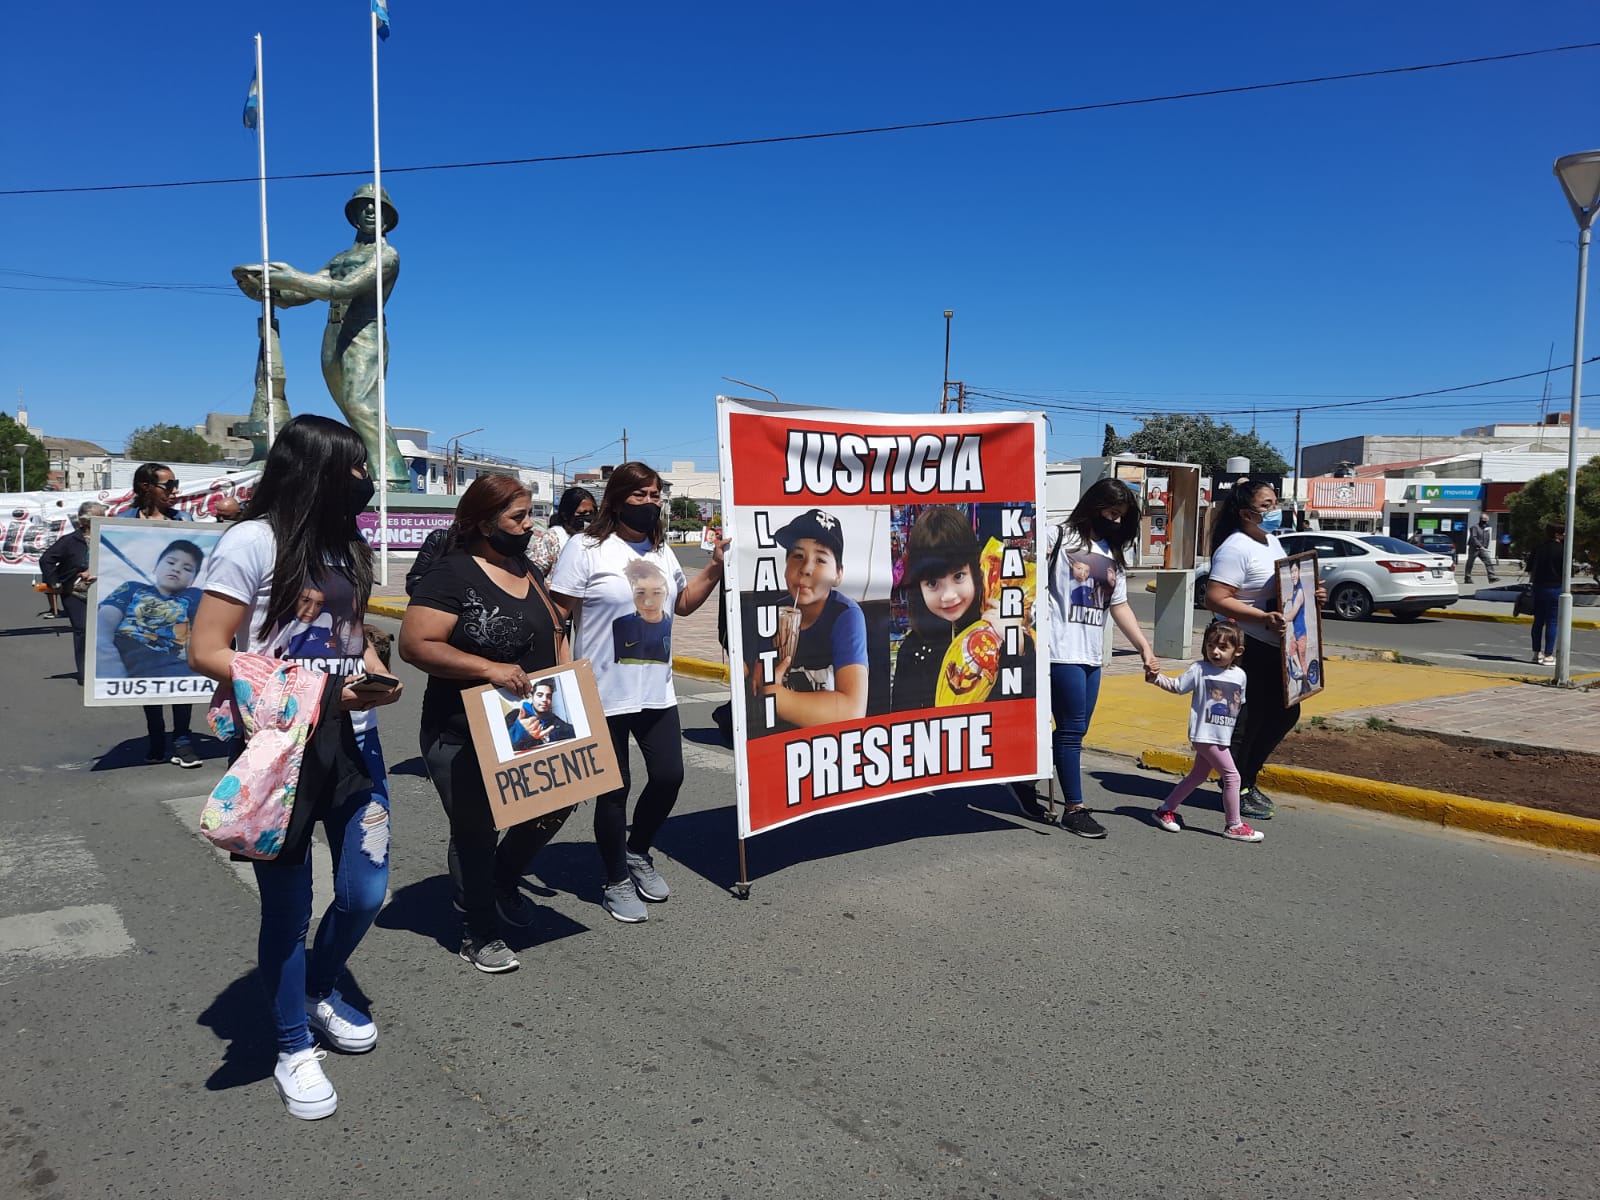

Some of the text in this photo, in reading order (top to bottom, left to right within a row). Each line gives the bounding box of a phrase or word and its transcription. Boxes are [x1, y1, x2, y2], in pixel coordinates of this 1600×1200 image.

[783, 430, 984, 494] JUSTICIA
[1443, 488, 1474, 496] movistar
[401, 518, 413, 526] DE
[754, 511, 780, 730] LAUTI
[1000, 507, 1026, 696] KARIN
[106, 679, 215, 696] JUSTICIA
[494, 743, 605, 805] PRESENTE
[785, 712, 993, 808] PRESENTE
